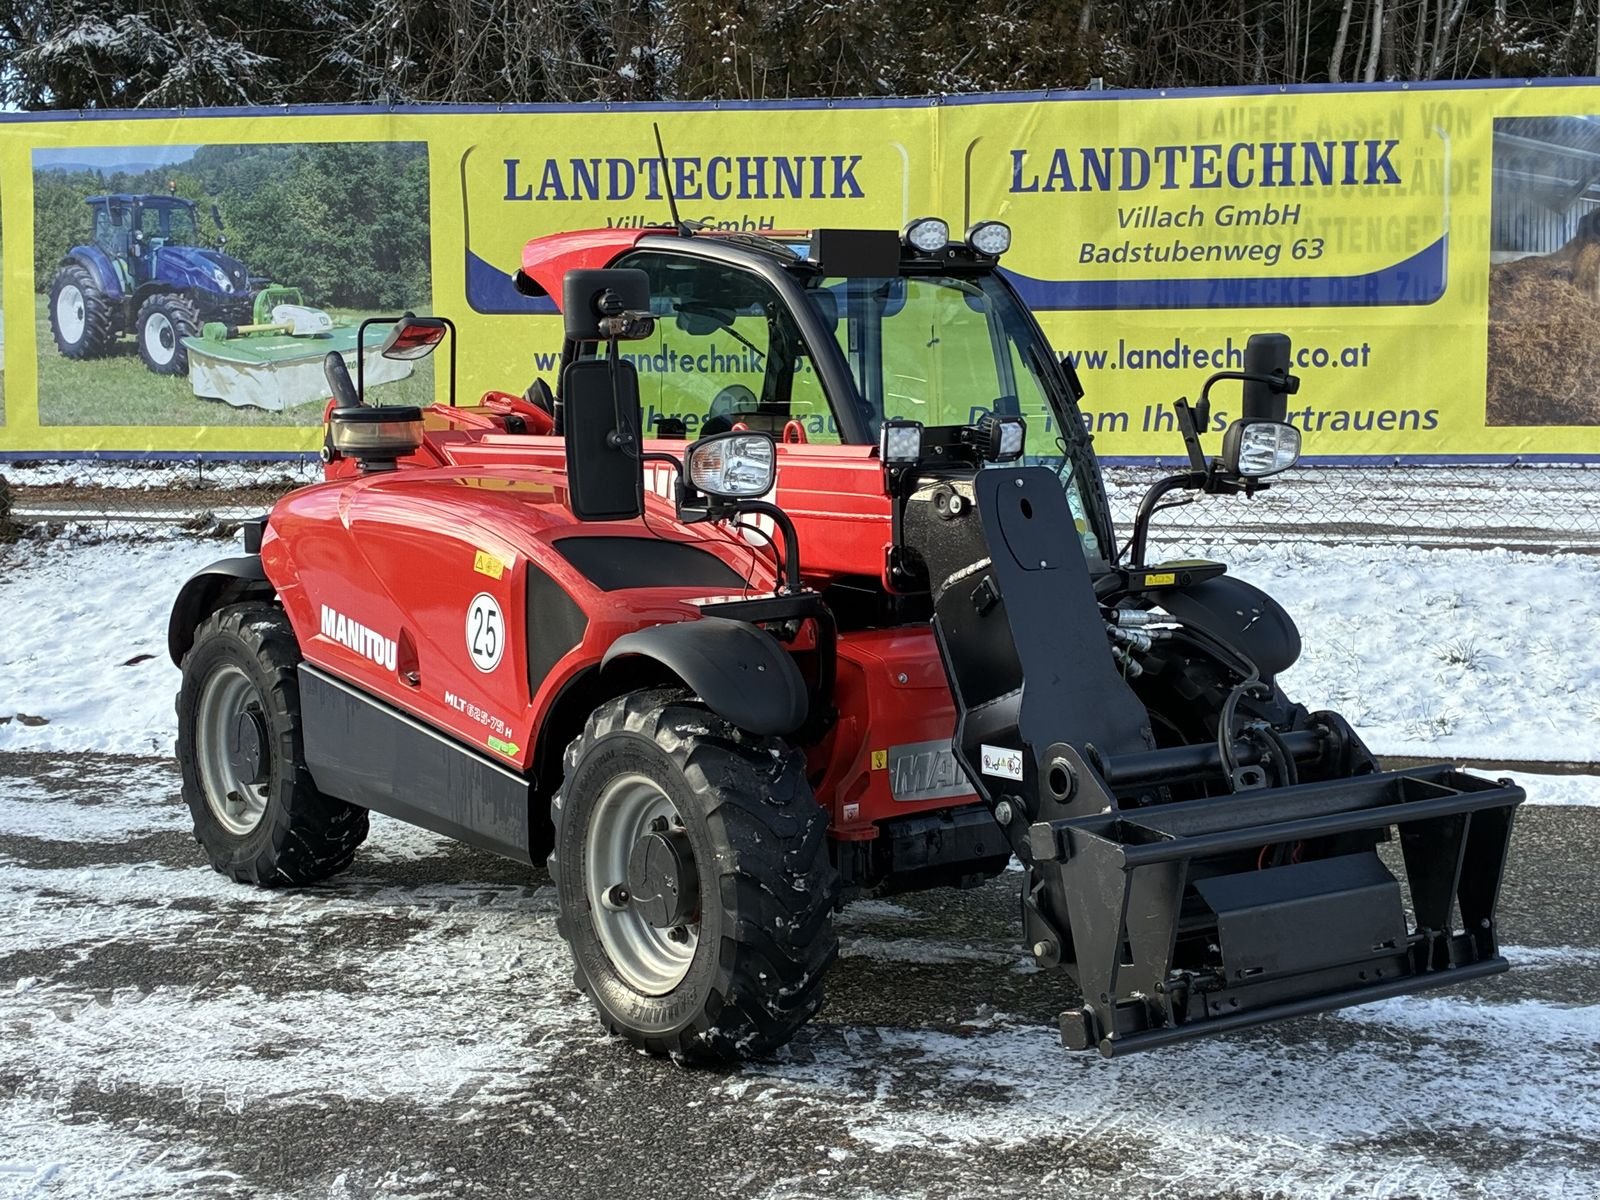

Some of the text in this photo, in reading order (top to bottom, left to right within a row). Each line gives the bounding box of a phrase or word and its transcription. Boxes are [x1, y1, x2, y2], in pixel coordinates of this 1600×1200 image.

[503, 155, 865, 201] LANDTECHNIK
[1009, 139, 1401, 194] LANDTECHNIK
[1117, 203, 1301, 229] Villach GmbH
[1079, 238, 1324, 266] Badstubenweg 63
[320, 603, 397, 671] MANITOU
[473, 606, 497, 658] 25
[444, 690, 467, 713] MLT
[504, 726, 513, 739] H
